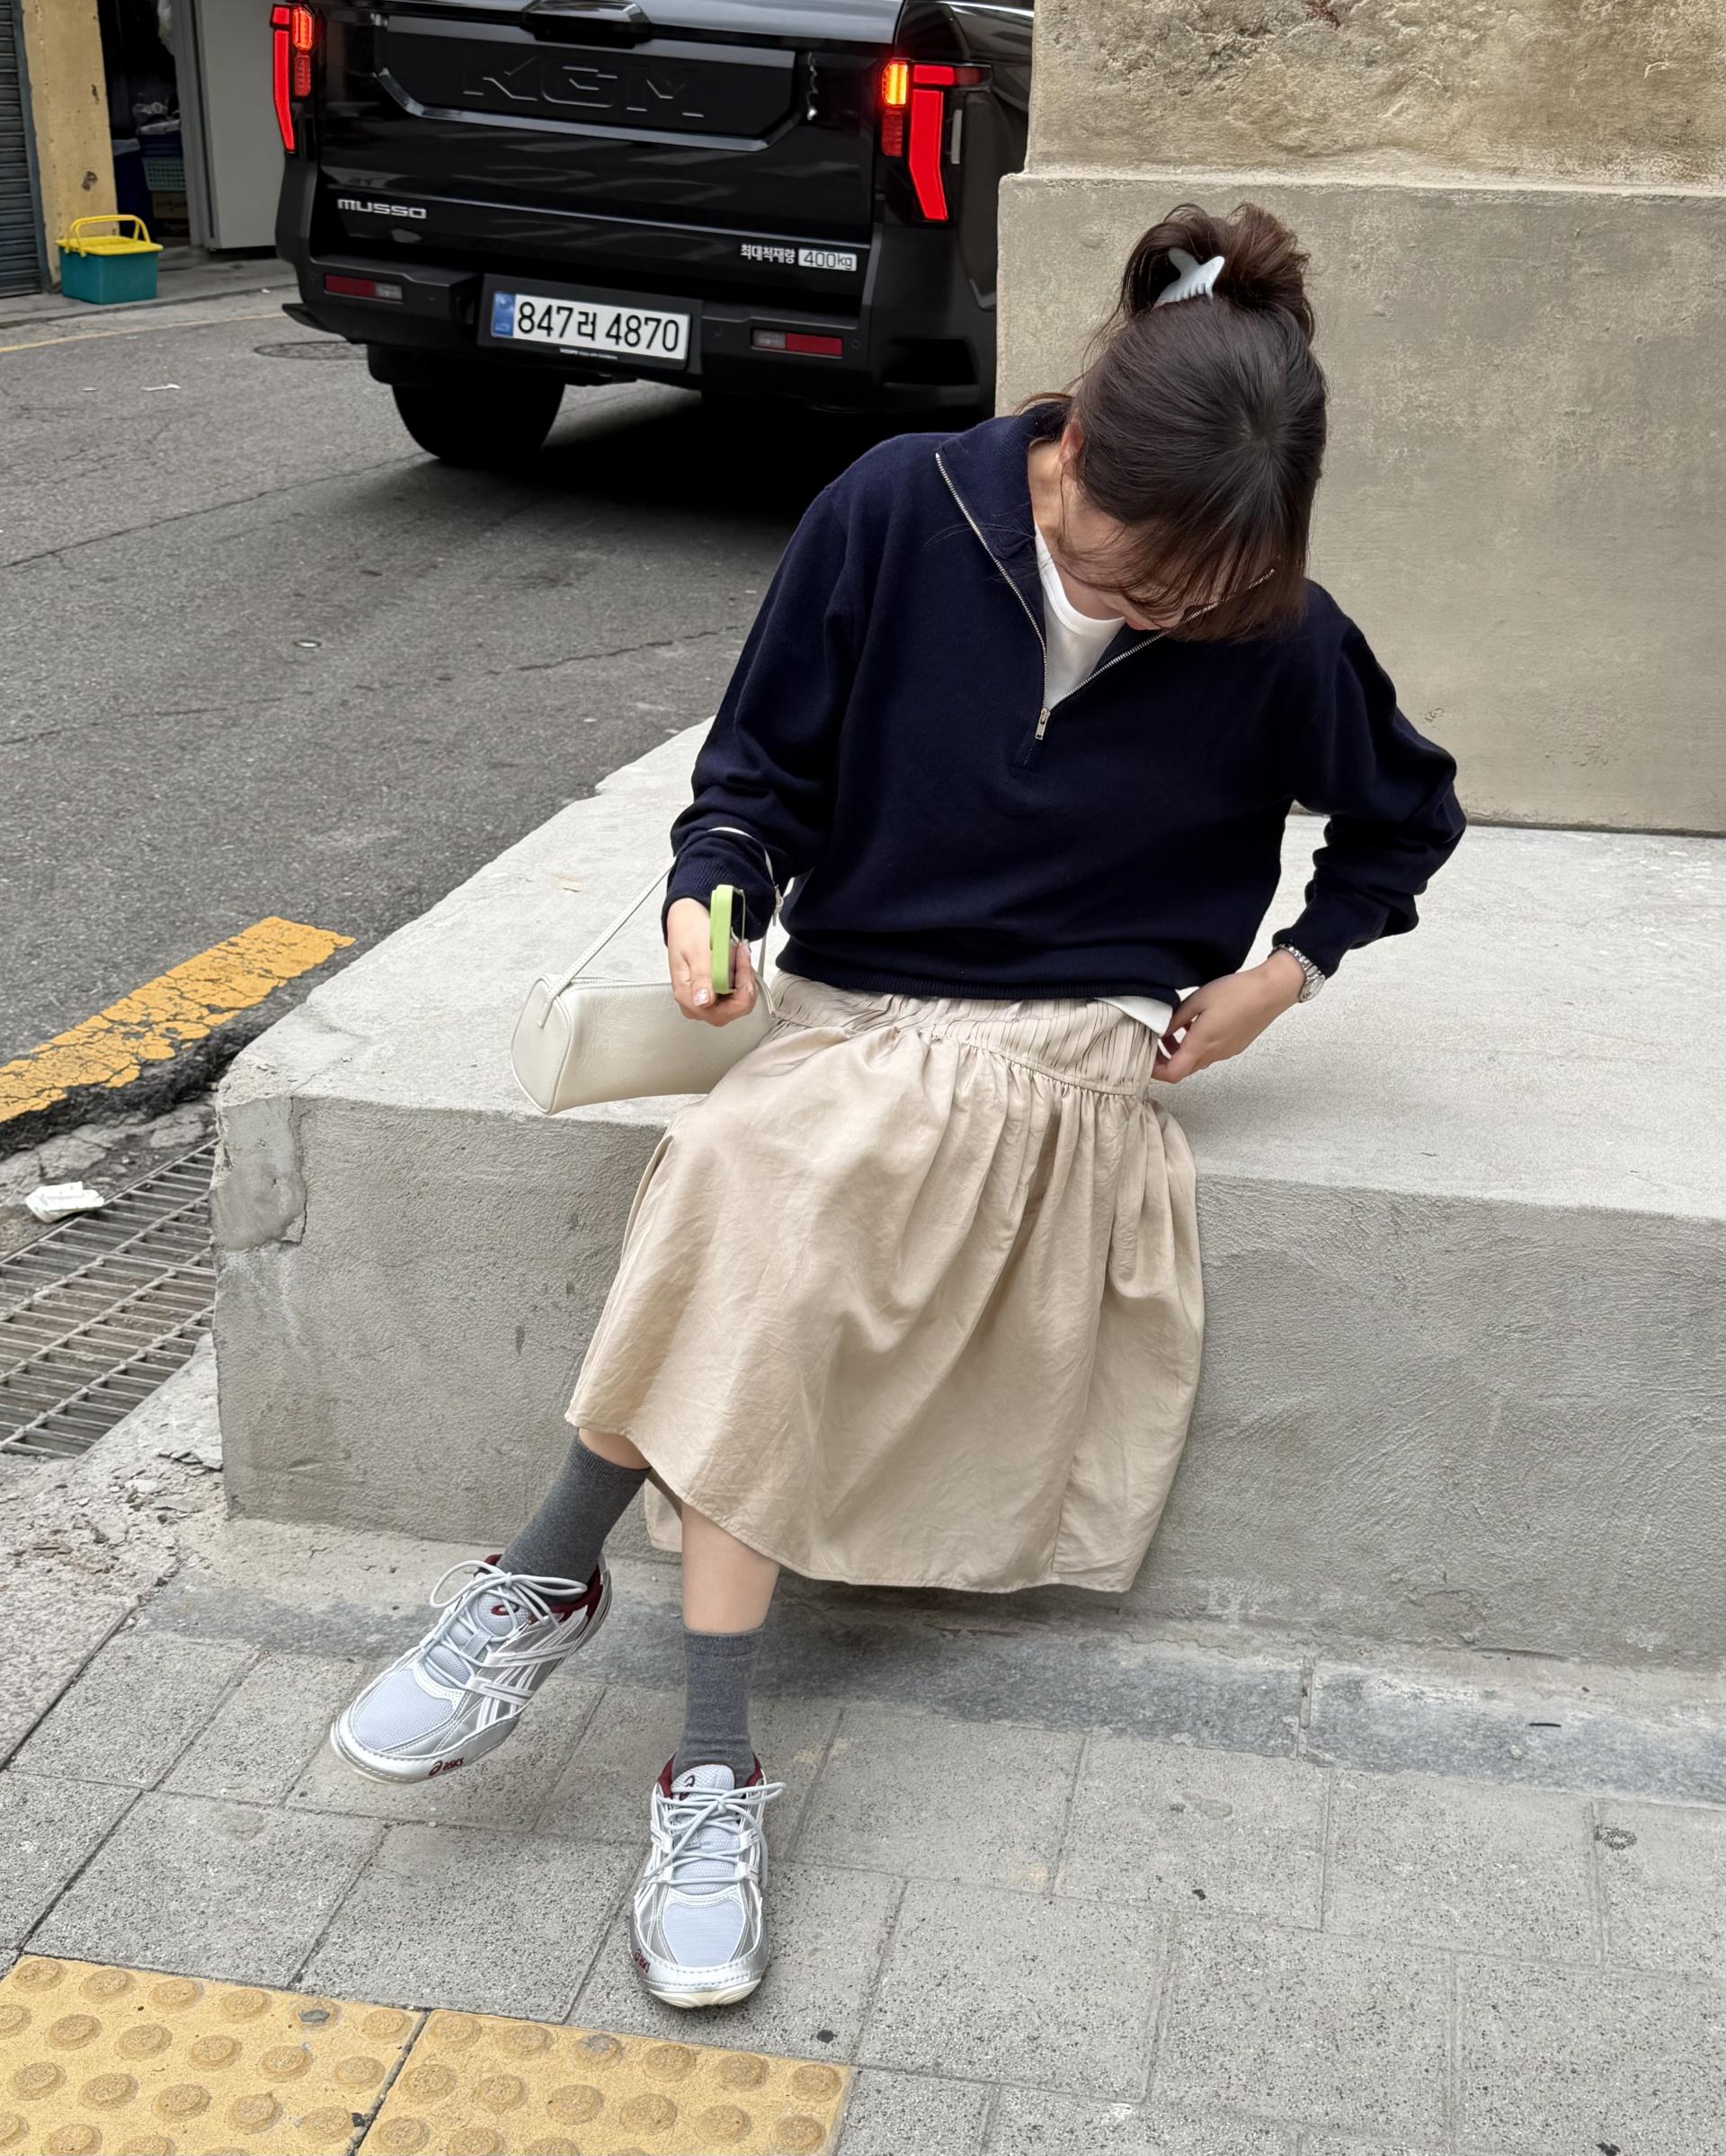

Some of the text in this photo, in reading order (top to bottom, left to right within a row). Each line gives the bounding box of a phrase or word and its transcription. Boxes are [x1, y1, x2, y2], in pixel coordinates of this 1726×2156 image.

[463, 52, 704, 118] KGM
[337, 199, 427, 219] MUSSO
[740, 244, 853, 270] 최대적재량 400kg
[518, 301, 680, 352] 847러 4870
